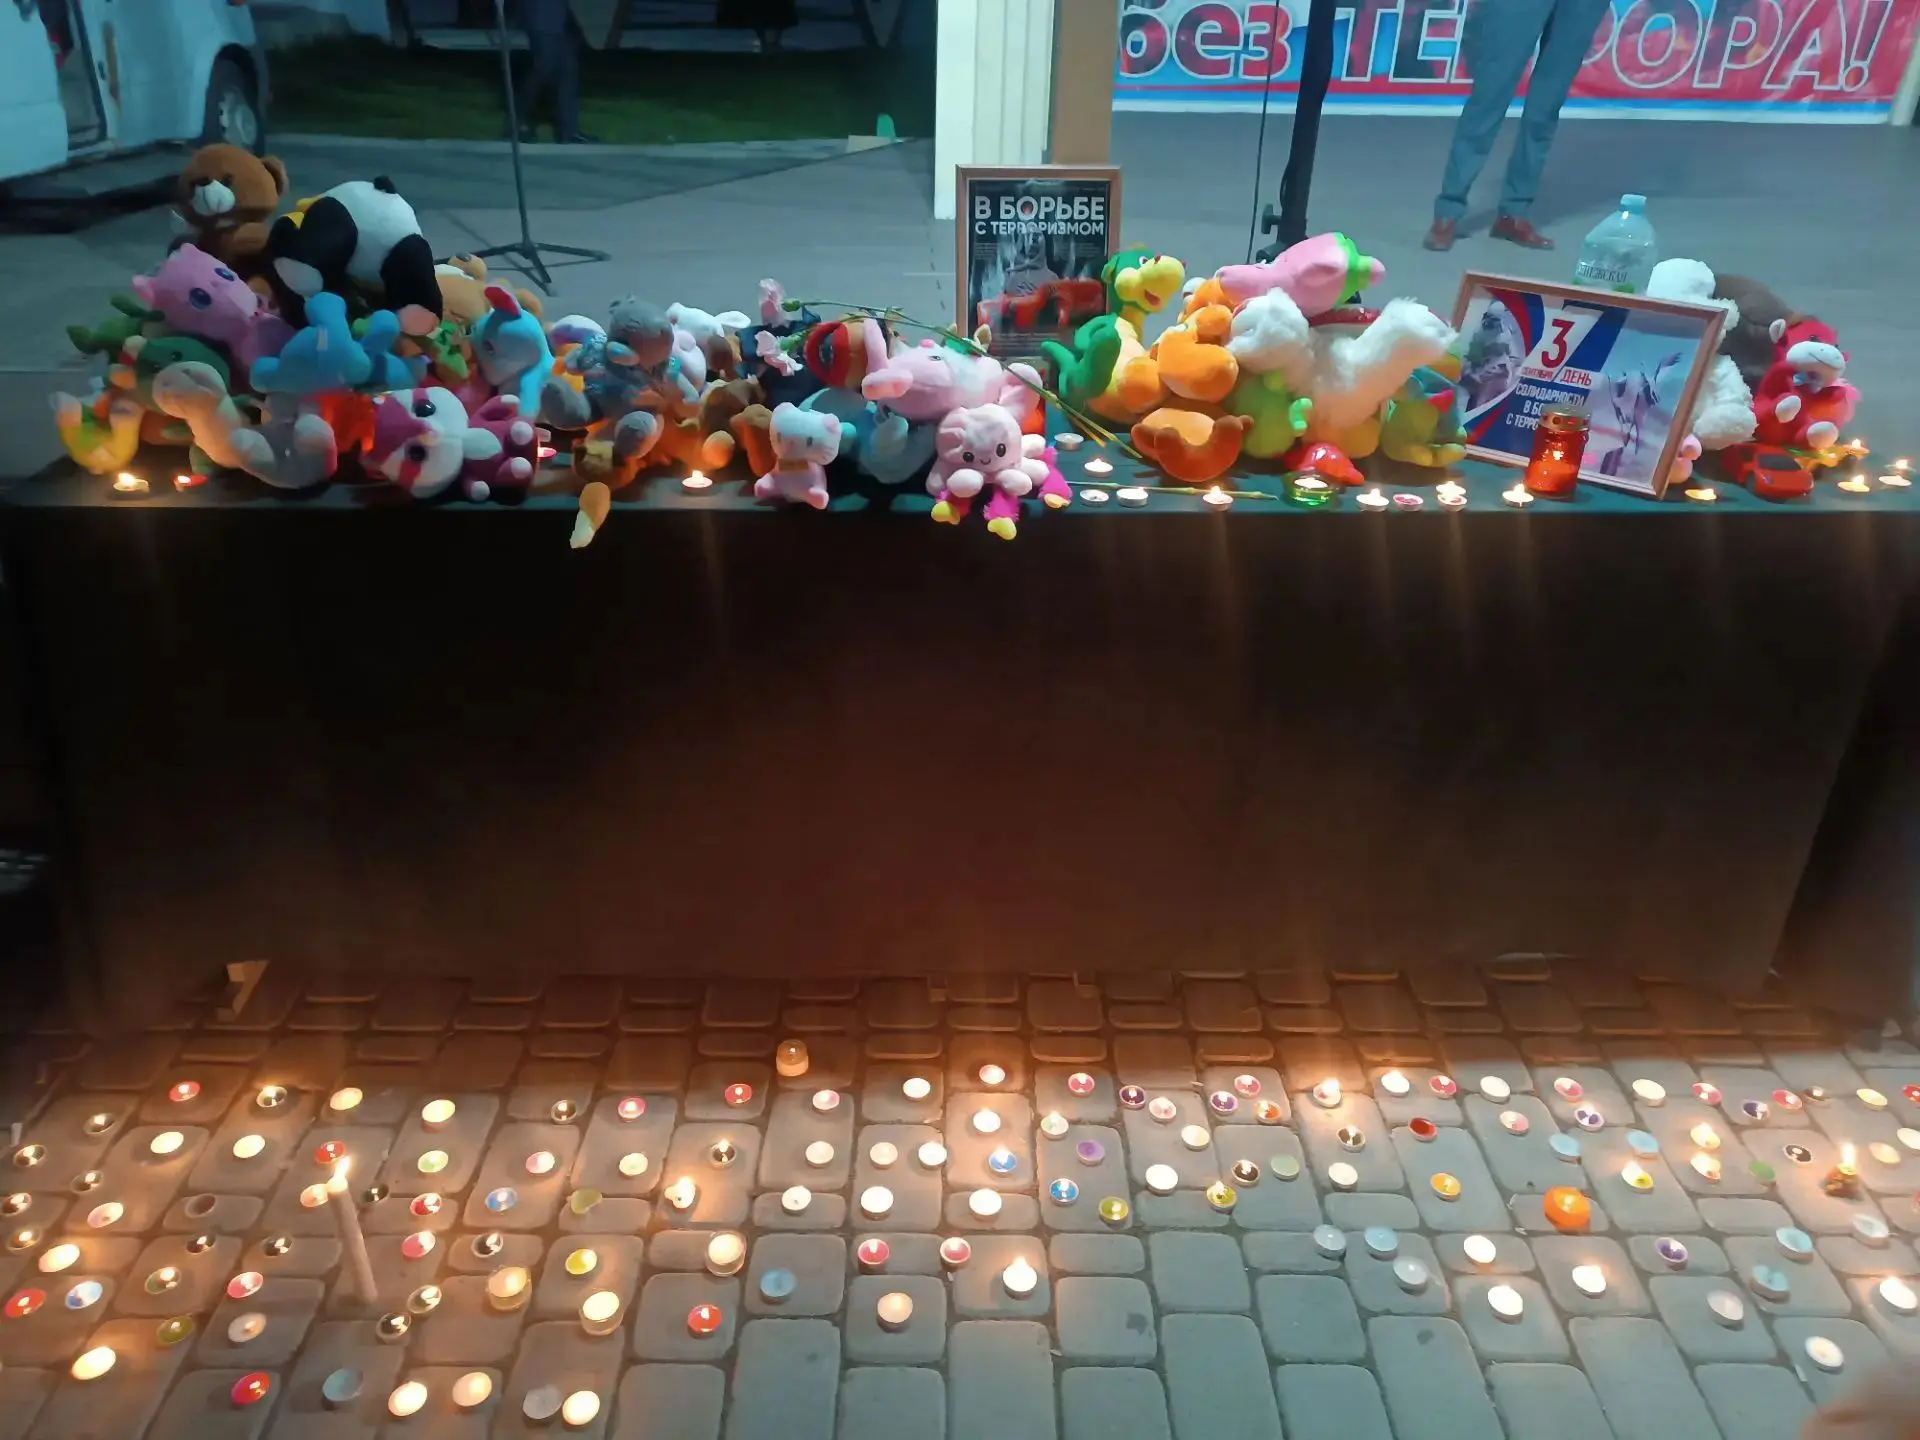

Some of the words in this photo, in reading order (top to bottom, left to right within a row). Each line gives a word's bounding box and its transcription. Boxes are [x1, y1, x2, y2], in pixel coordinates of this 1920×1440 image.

[1334, 0, 1891, 92] ТЕОРА!
[974, 196, 992, 220] В
[999, 196, 1105, 221] БОРЬБЕ
[975, 222, 987, 236] С
[990, 221, 1104, 236] ТЕРРОРИЗМОМ
[1541, 318, 1576, 369] 3
[1562, 368, 1592, 387] ДЕНЬ
[1515, 383, 1586, 407] СОЛИДАРНОСТИ
[1523, 399, 1532, 414] В
[1505, 413, 1514, 425] С
